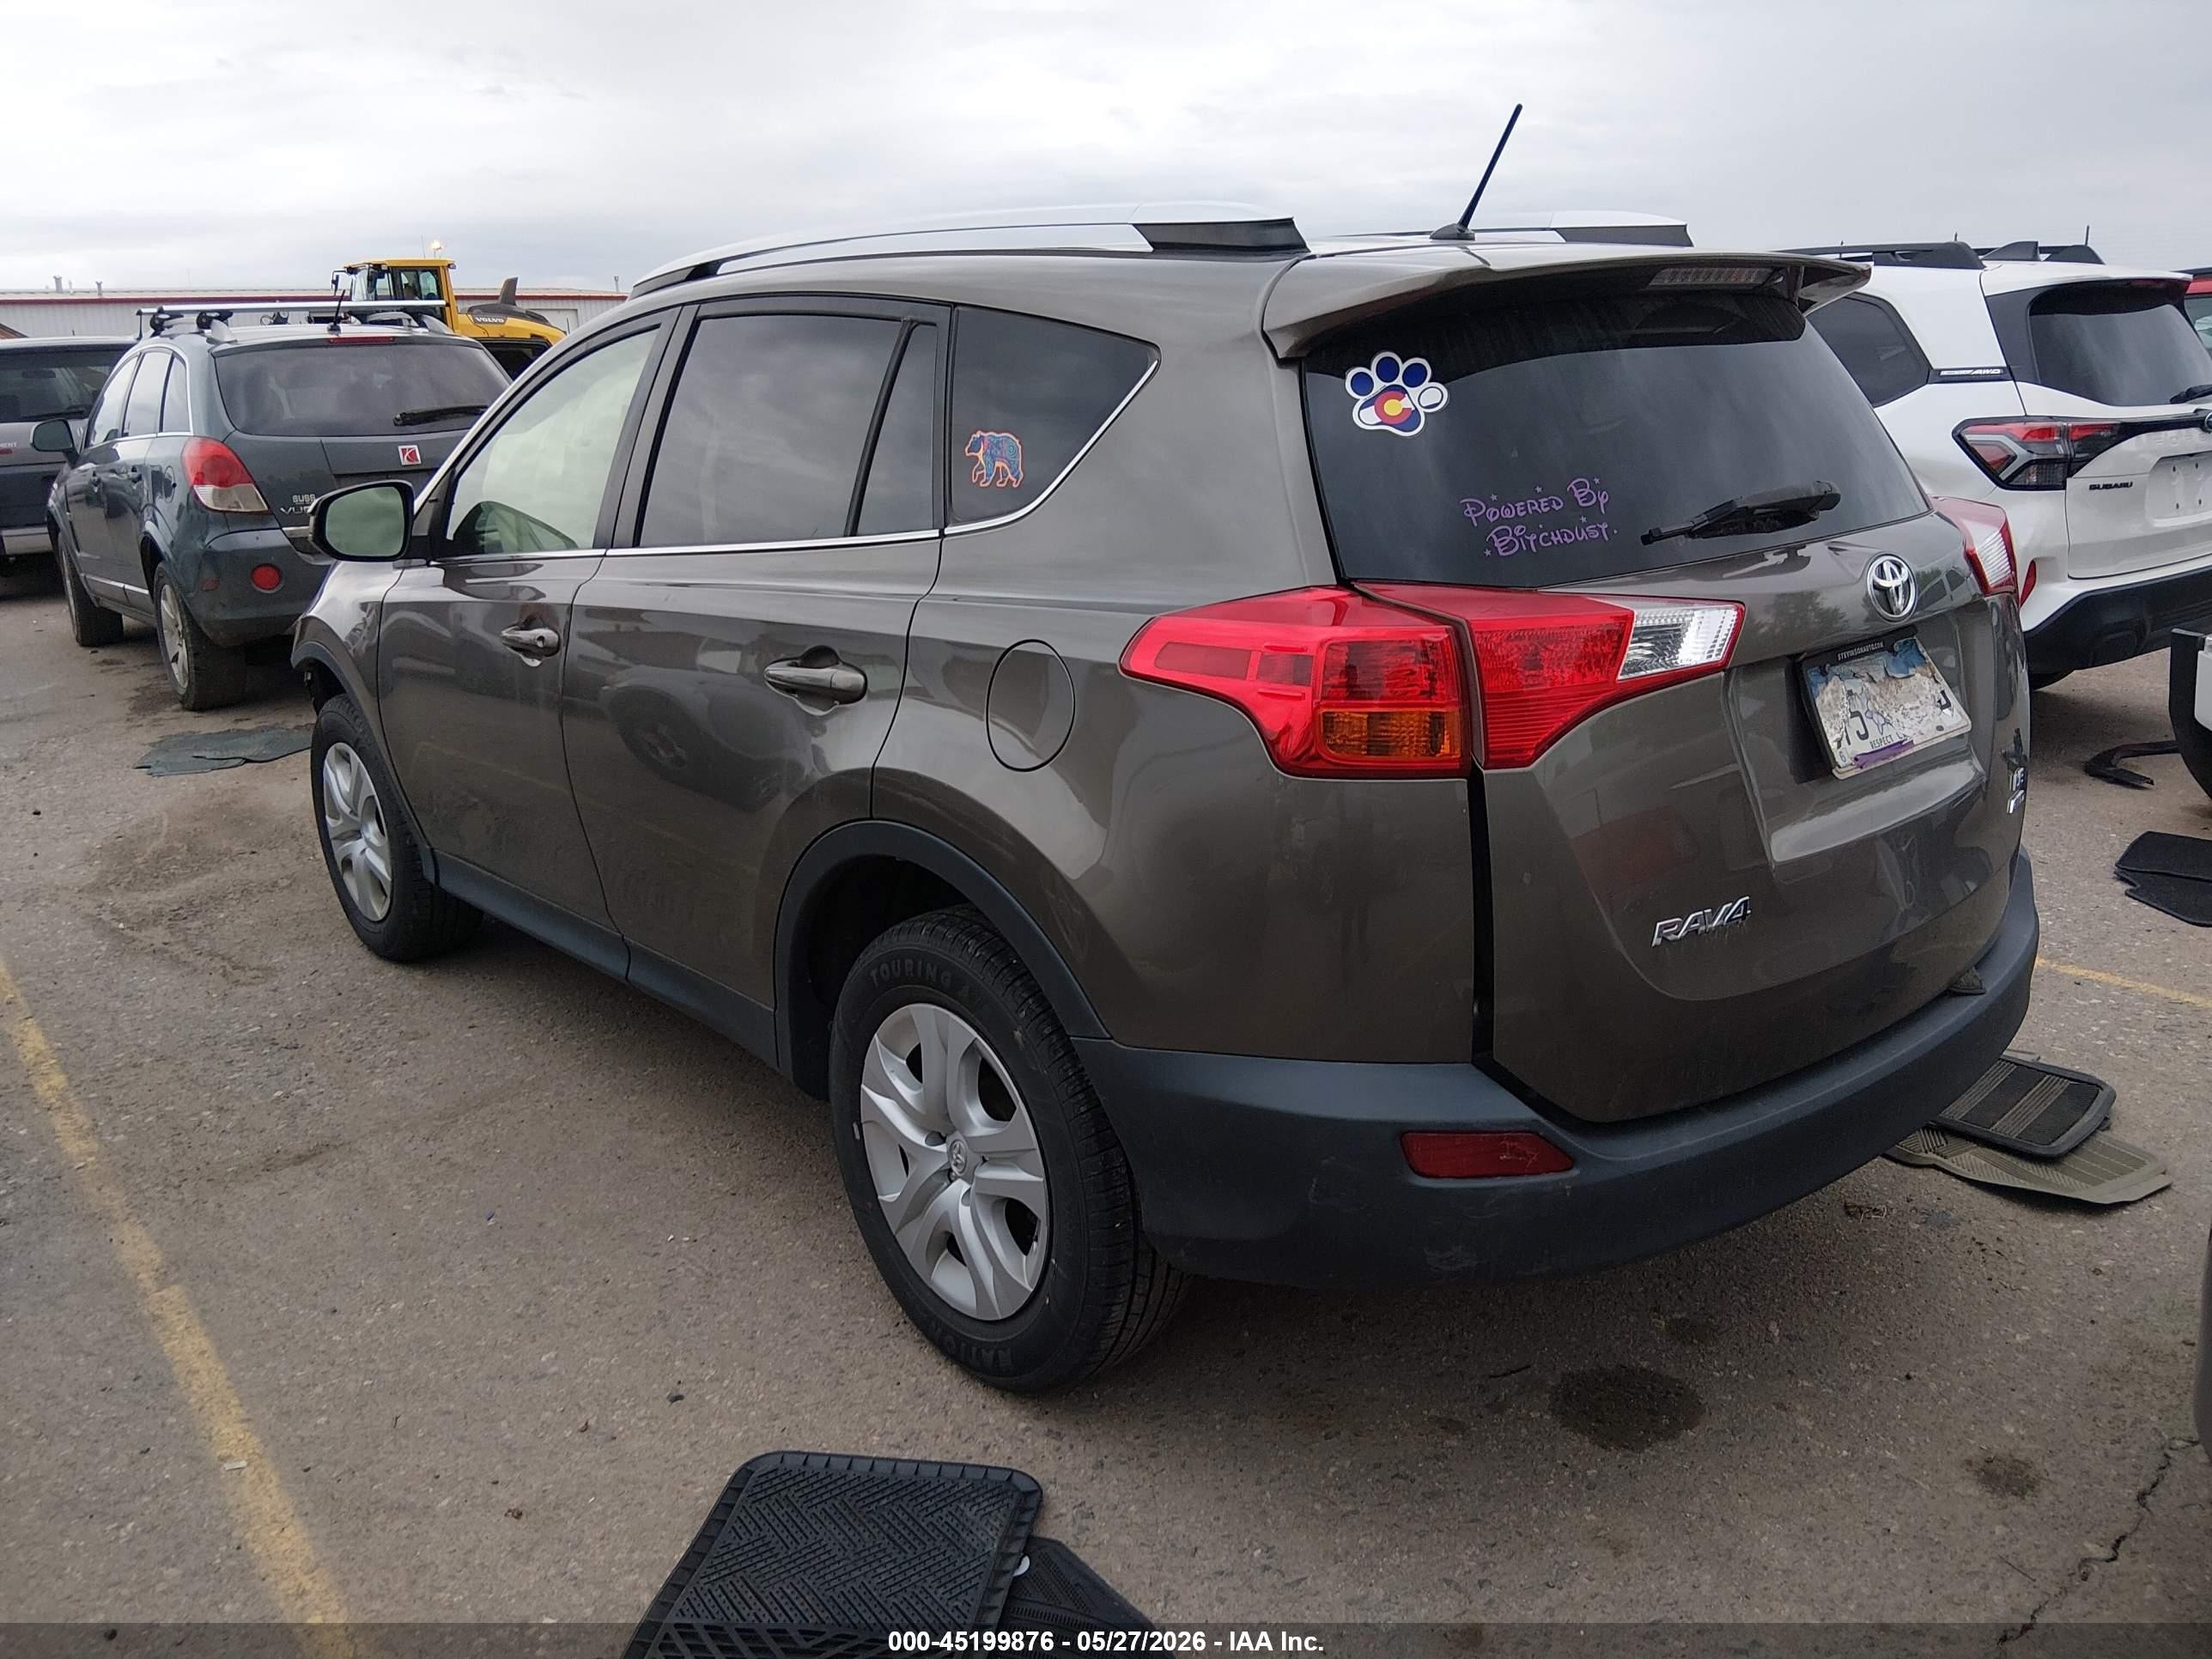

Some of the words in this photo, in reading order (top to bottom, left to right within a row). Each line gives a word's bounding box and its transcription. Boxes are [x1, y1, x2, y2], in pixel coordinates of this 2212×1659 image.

[2088, 481, 2134, 490] SUBARU
[1869, 733, 1894, 750] RESPECT
[1651, 896, 1751, 948] RAV4
[870, 958, 952, 989] TOURING
